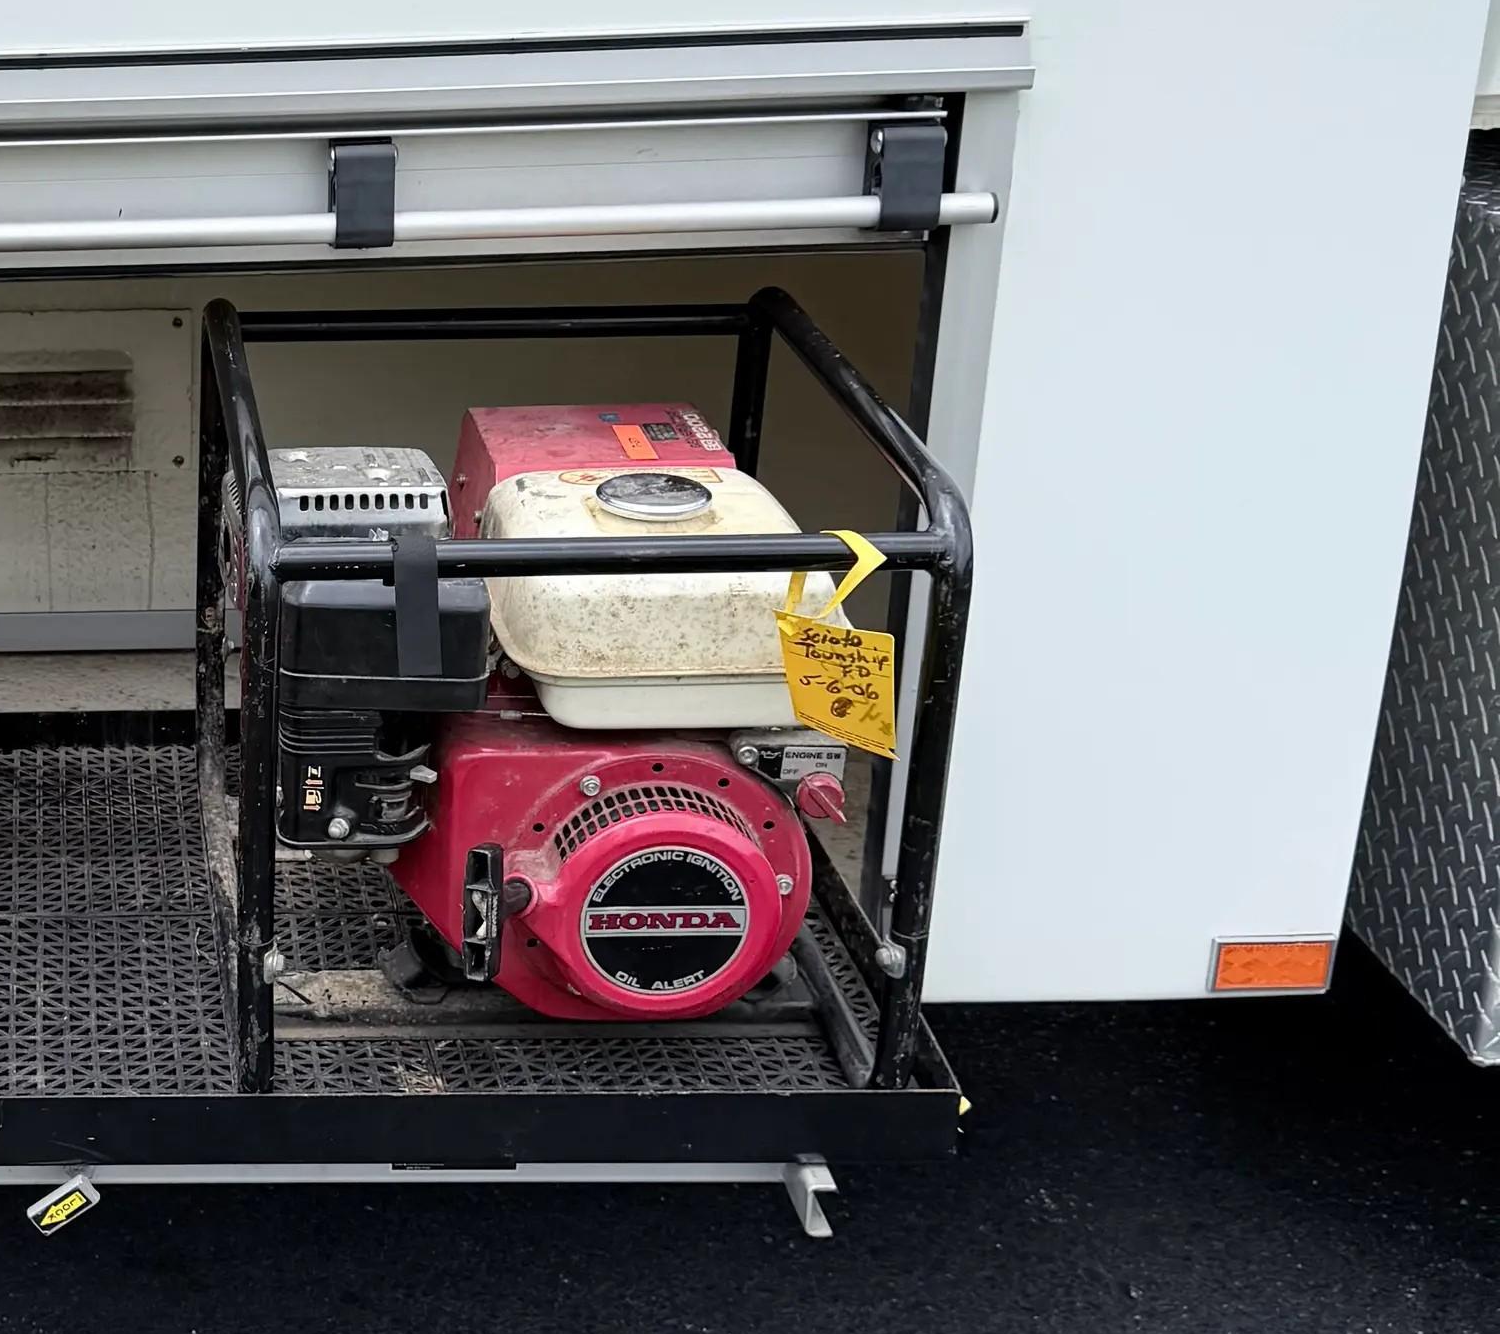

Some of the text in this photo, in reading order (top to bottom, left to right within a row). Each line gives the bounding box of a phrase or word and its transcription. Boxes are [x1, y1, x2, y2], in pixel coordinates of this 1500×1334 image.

[793, 641, 889, 671] Township
[785, 751, 823, 759] ENGINE
[592, 851, 742, 903] ELECTRONIC IGNITION
[588, 912, 741, 930] HONDA
[614, 970, 705, 990] OIL ALERT
[47, 1197, 77, 1222] LOCK
